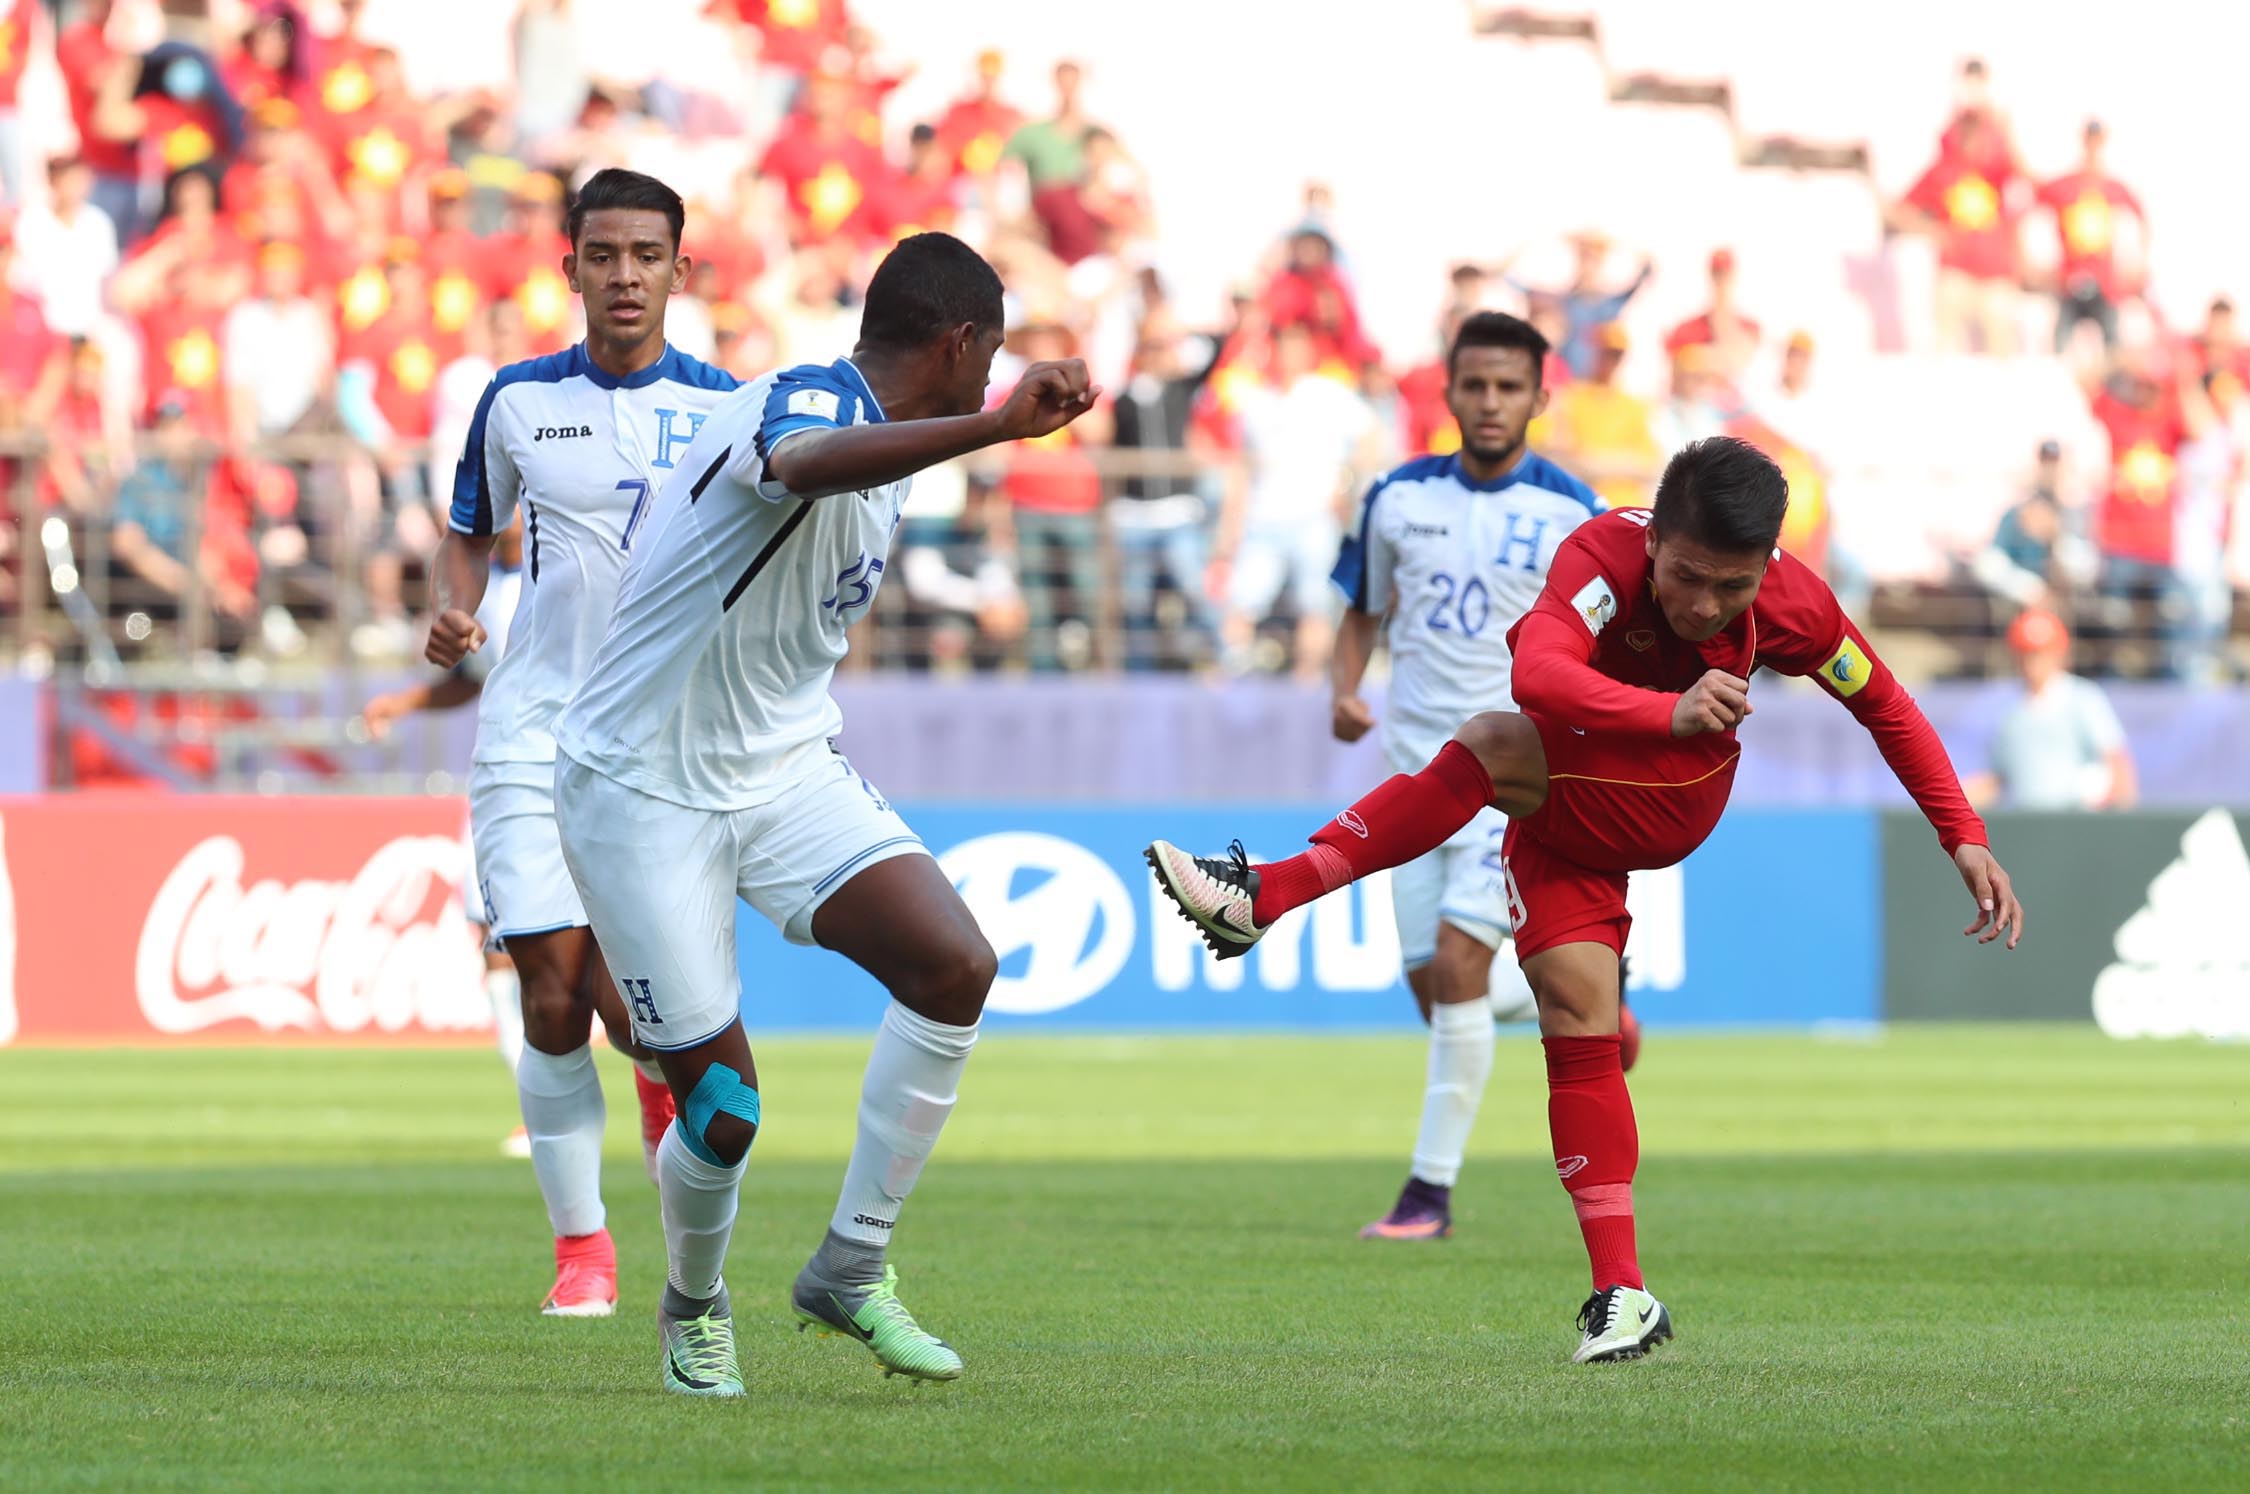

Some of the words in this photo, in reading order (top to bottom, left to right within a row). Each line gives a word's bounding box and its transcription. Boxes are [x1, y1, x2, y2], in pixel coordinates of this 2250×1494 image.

[534, 425, 592, 442] Joma
[615, 478, 650, 550] 7
[1494, 512, 1548, 571] H
[822, 550, 884, 618] 15
[1426, 570, 1490, 637] 20
[622, 978, 663, 1024] H
